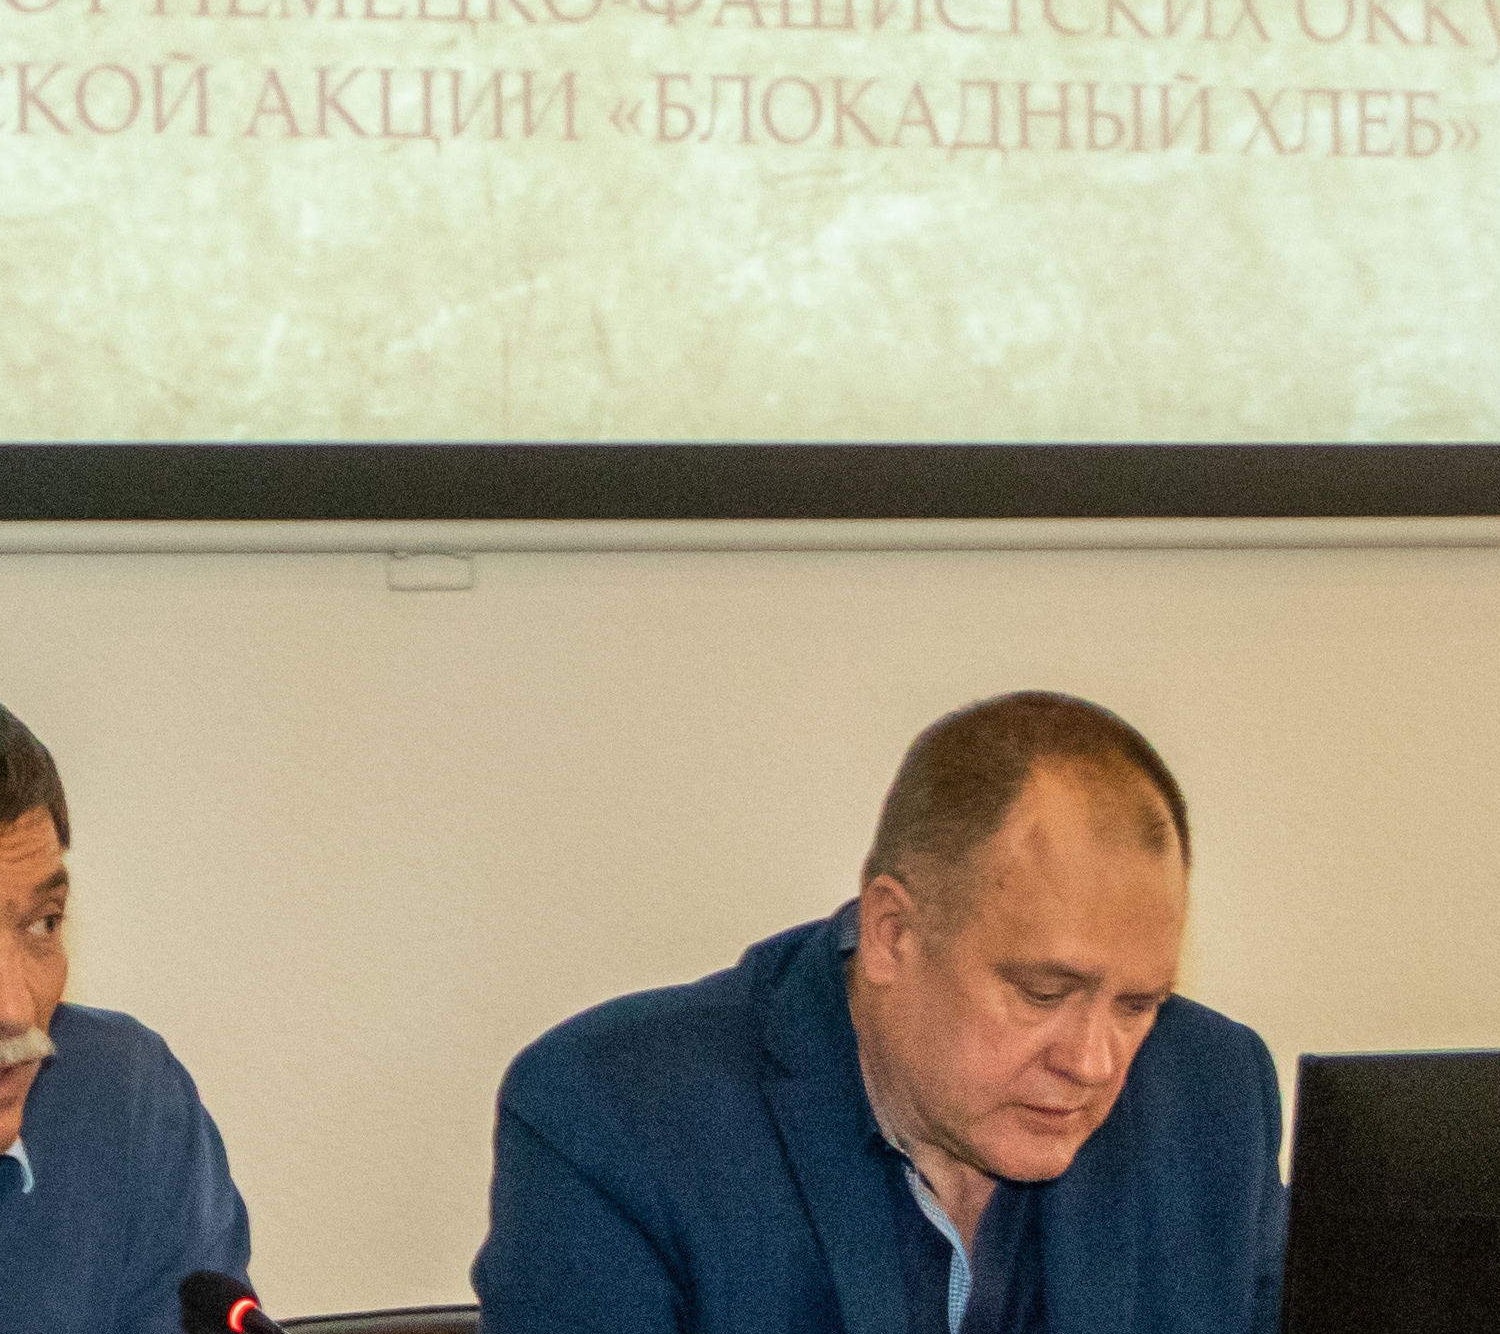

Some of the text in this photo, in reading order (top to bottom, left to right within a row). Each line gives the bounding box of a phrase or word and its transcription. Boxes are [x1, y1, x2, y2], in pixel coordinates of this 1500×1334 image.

[243, 65, 585, 149] АКЦИИ
[607, 69, 1218, 162] «БЛОКАДНЫЙ
[1238, 83, 1484, 160] ХЛЕБ»
